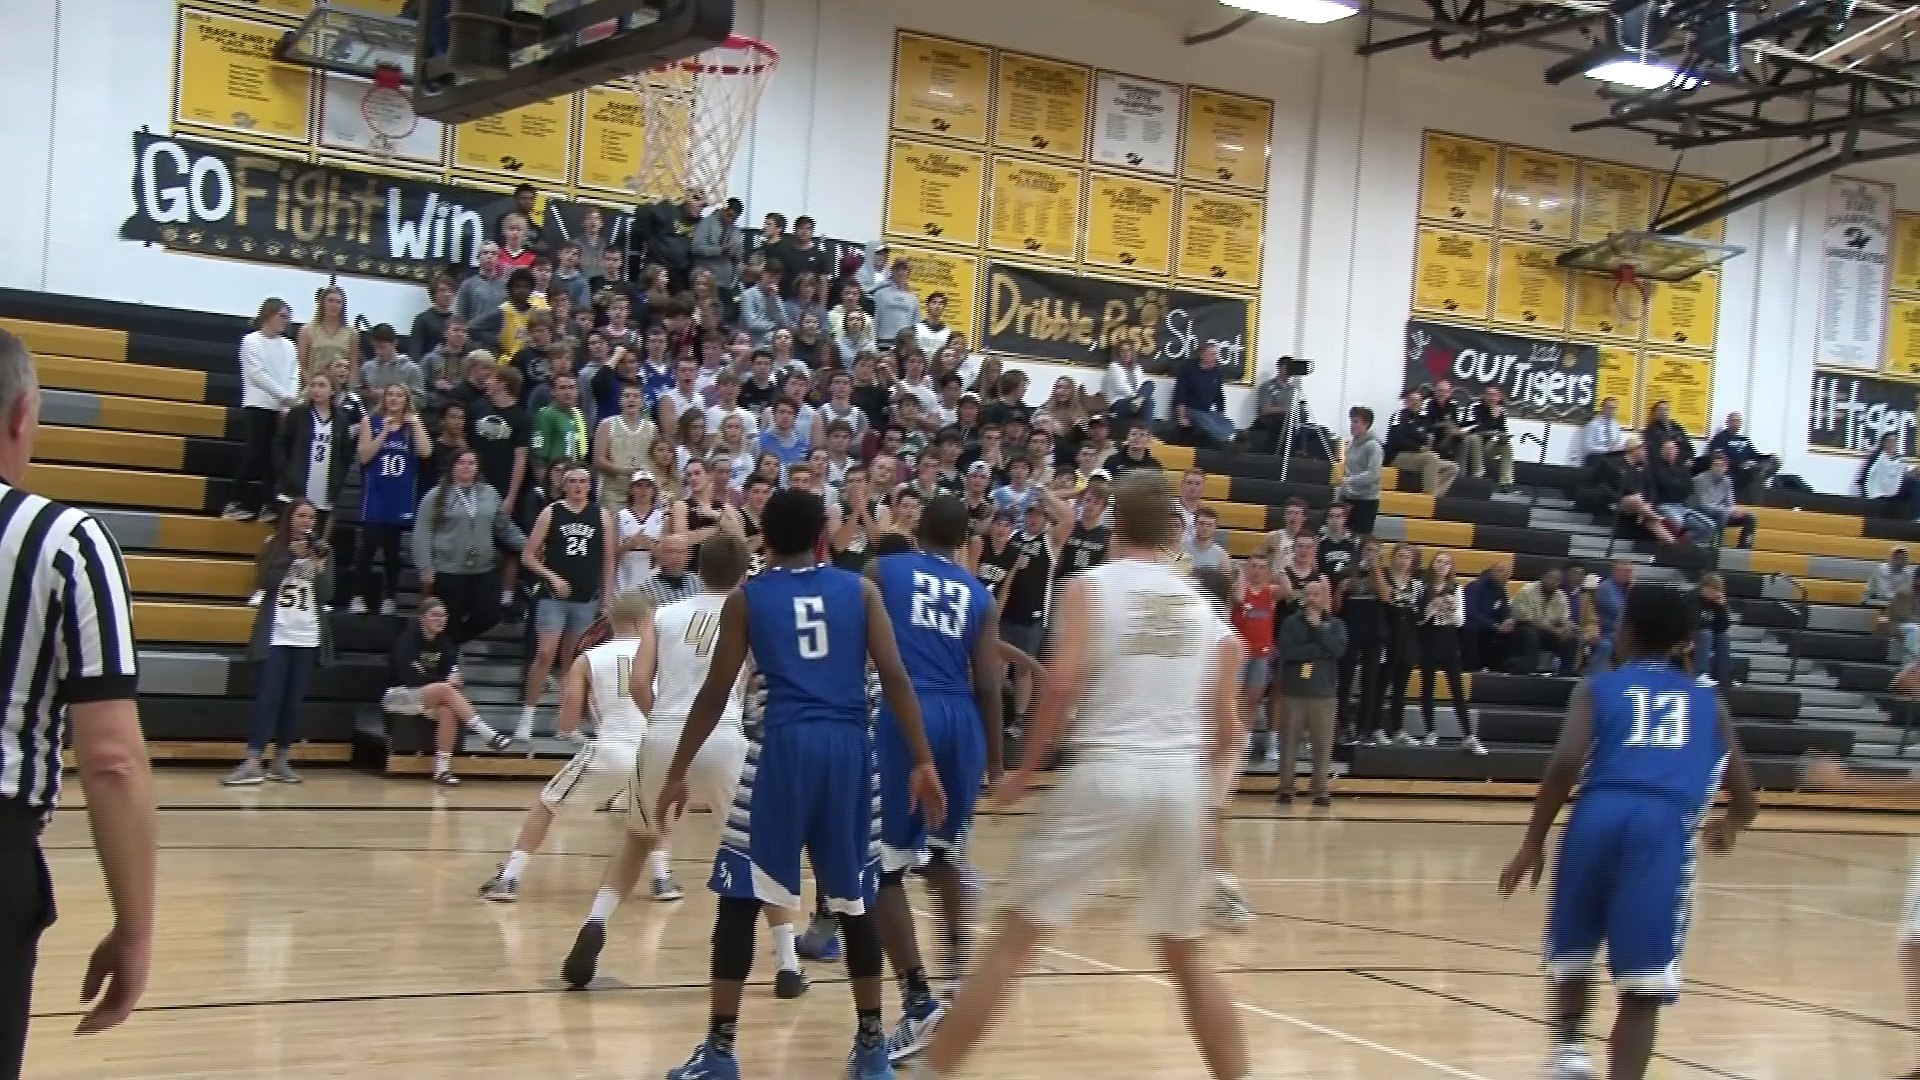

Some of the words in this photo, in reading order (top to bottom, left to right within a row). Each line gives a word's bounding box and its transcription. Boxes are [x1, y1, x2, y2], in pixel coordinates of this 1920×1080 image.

[234, 155, 386, 243] Fight
[386, 186, 485, 269] Win
[1509, 362, 1595, 408] Tigers
[378, 454, 406, 478] 10
[558, 523, 596, 541] TIGERS
[565, 537, 588, 558] 24
[276, 585, 311, 613] 51
[910, 570, 972, 640] 23
[792, 596, 830, 662] 5
[1621, 688, 1689, 751] 13
